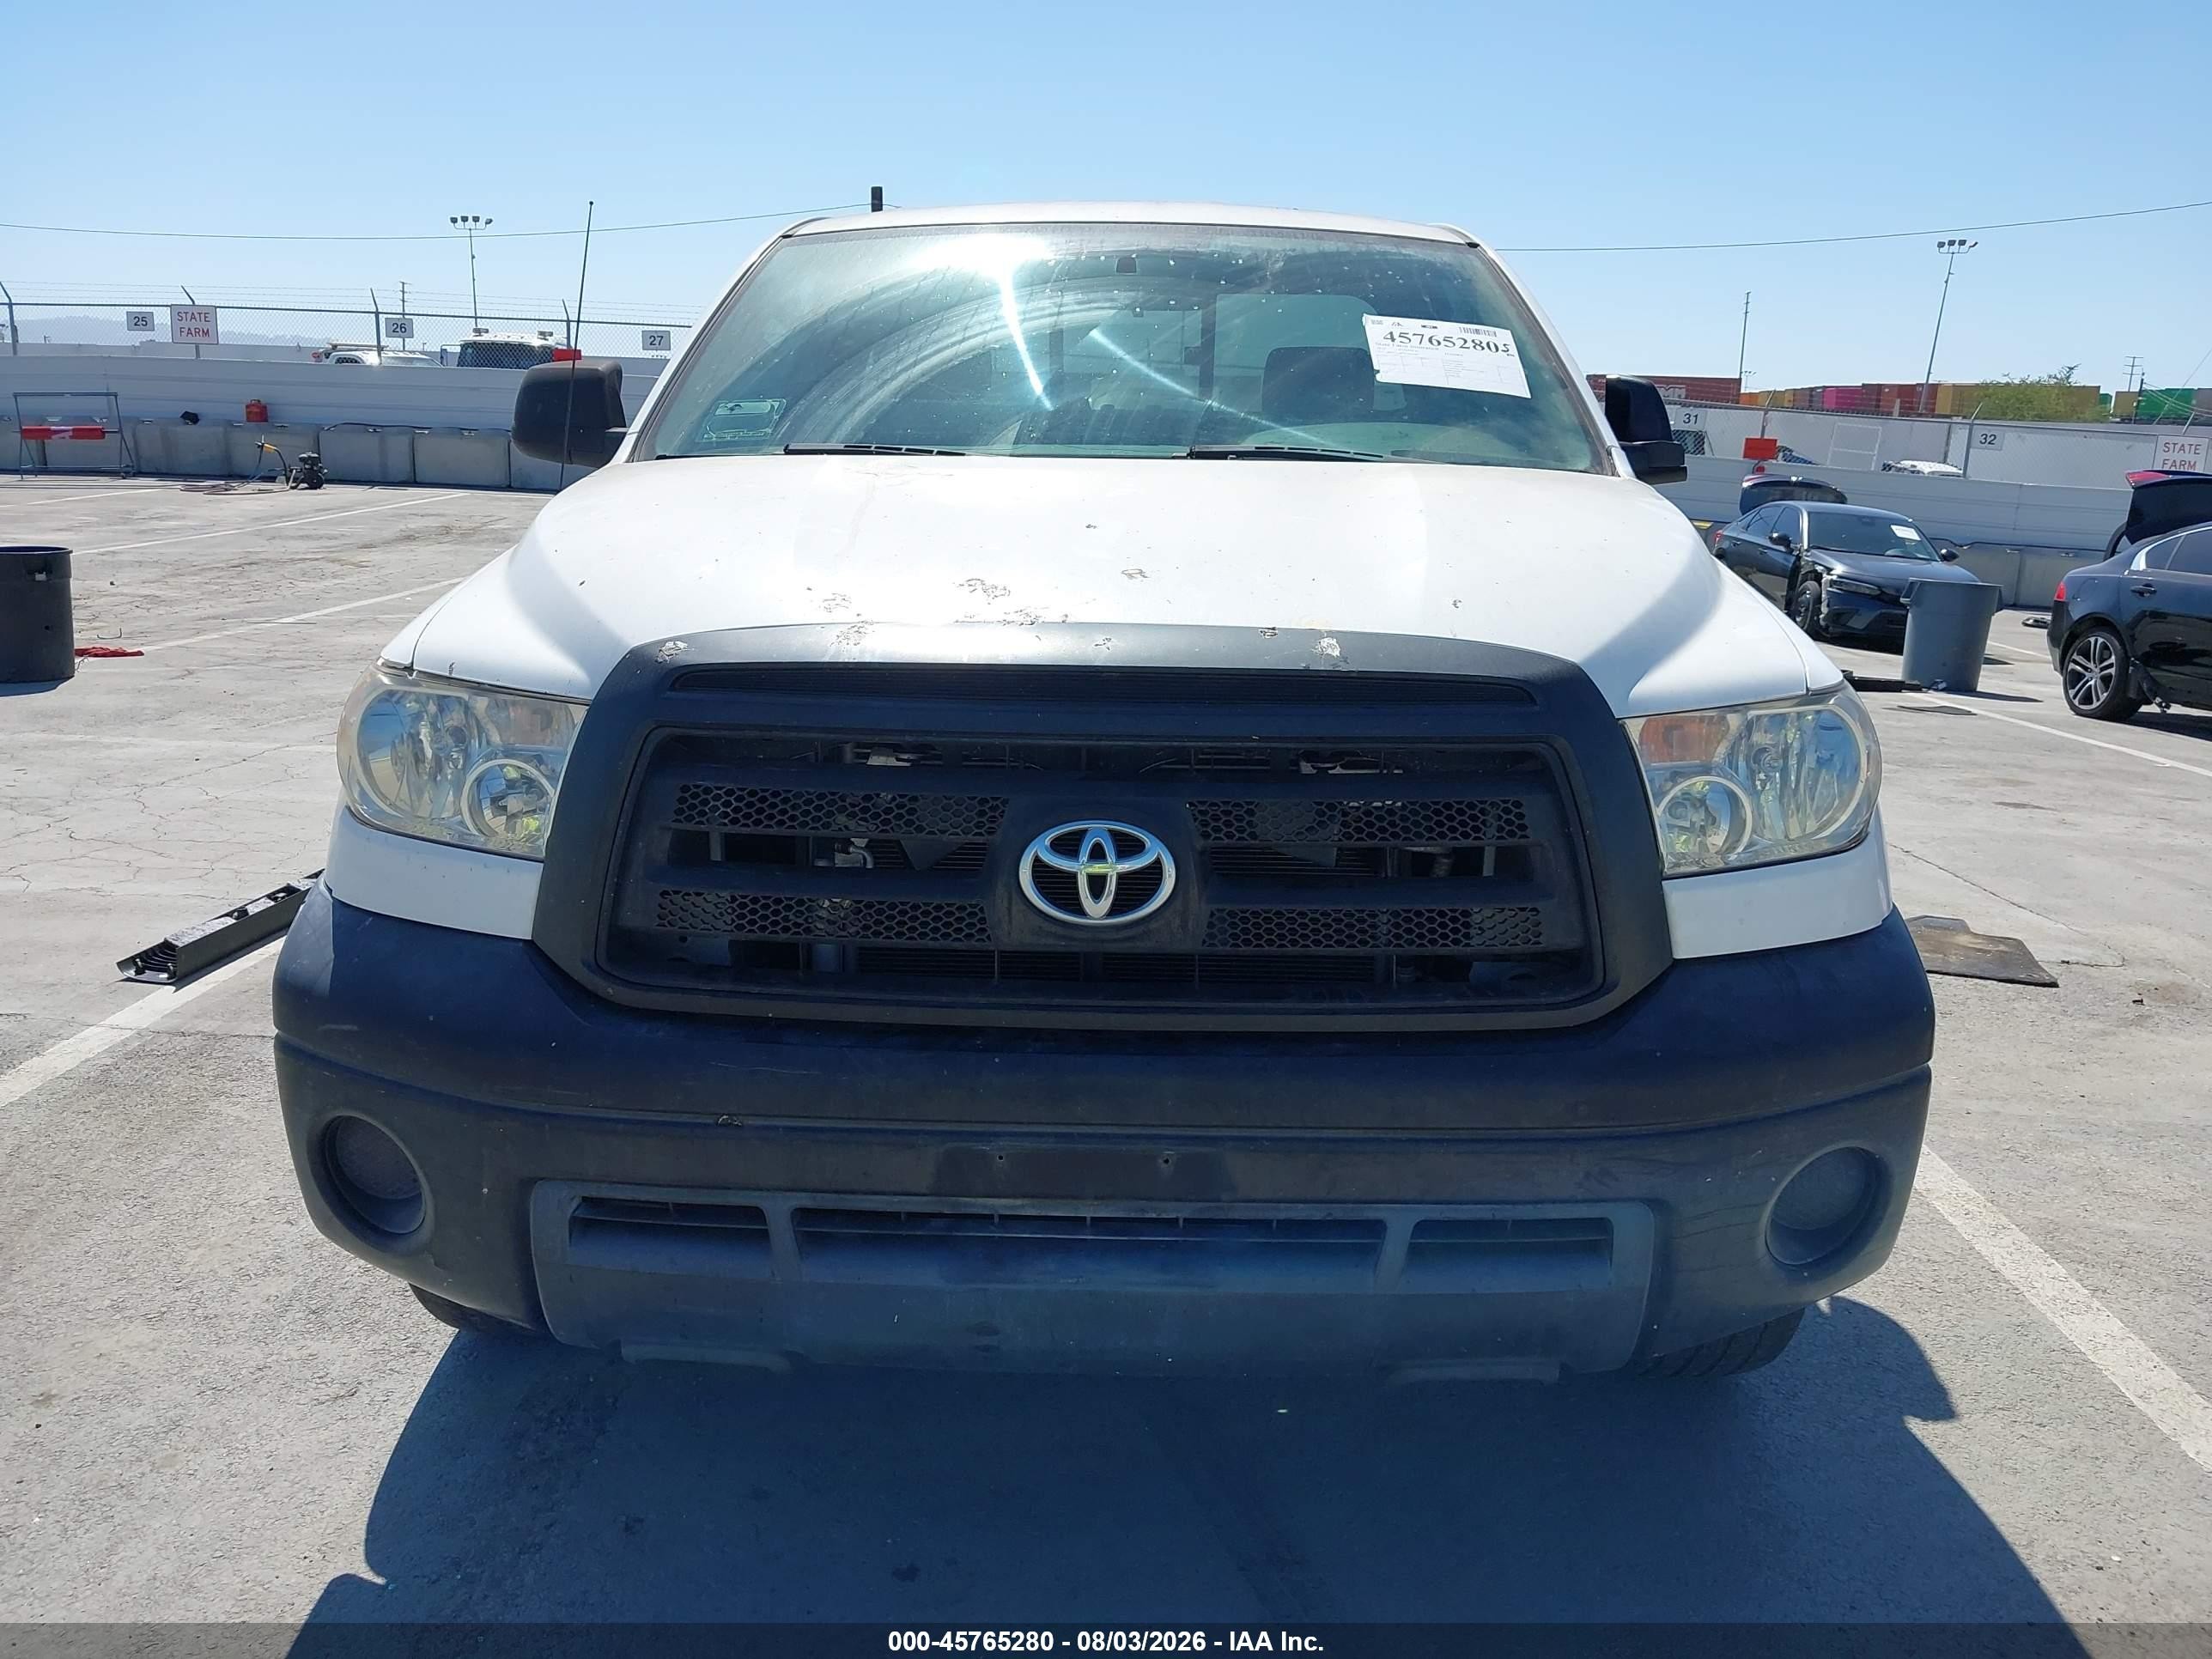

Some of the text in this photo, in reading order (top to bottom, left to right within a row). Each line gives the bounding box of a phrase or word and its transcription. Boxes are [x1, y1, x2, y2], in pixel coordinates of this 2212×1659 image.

[133, 316, 148, 326] 25
[177, 312, 210, 323] STATE
[179, 327, 210, 337] FARM
[392, 322, 407, 333] 26
[648, 335, 664, 346] 27
[1382, 331, 1499, 354] 45765280
[1682, 413, 1699, 424] 31
[1979, 433, 1997, 445] 32
[2162, 441, 2202, 455] STATE
[2161, 459, 2197, 471] FARM
